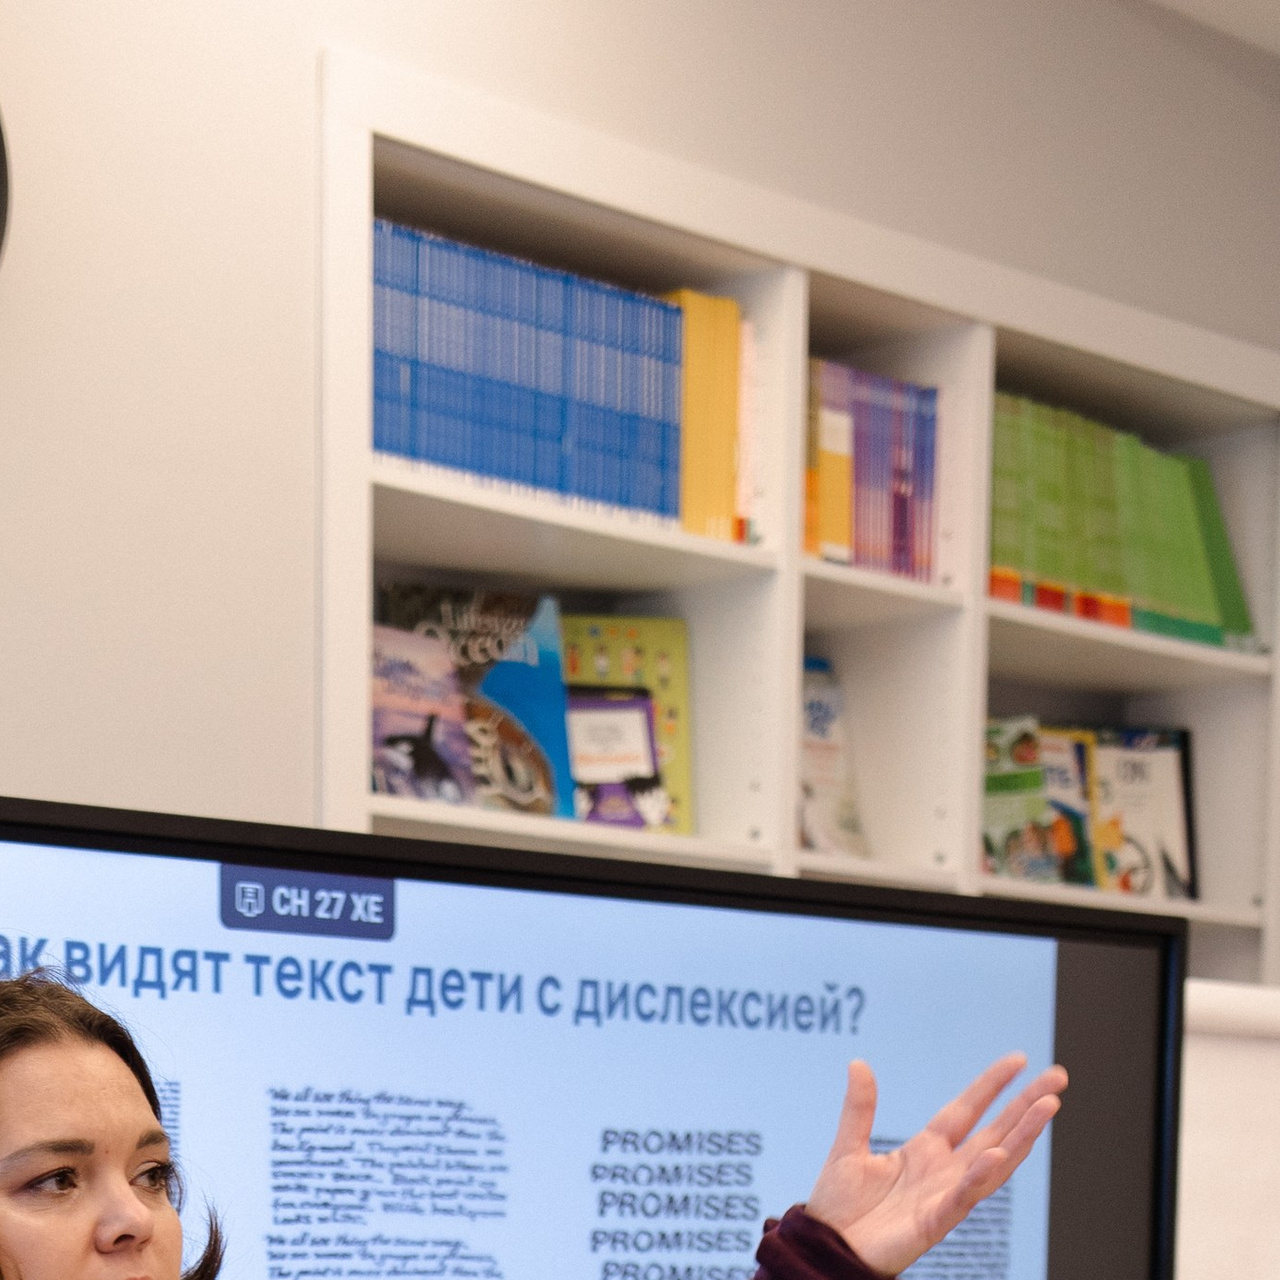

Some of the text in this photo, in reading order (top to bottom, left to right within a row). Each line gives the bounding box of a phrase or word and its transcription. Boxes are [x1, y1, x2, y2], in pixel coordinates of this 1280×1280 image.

[314, 890, 346, 920] 27
[64, 939, 231, 999] видят
[243, 953, 391, 1005] текст
[405, 964, 521, 1017] дети
[534, 975, 562, 1017] с
[570, 978, 863, 1034] дислексией?
[601, 1129, 762, 1155] PROMISES
[590, 1163, 753, 1187] PROMISES
[598, 1191, 760, 1221] PROMISES
[591, 1230, 752, 1253] PROMISES
